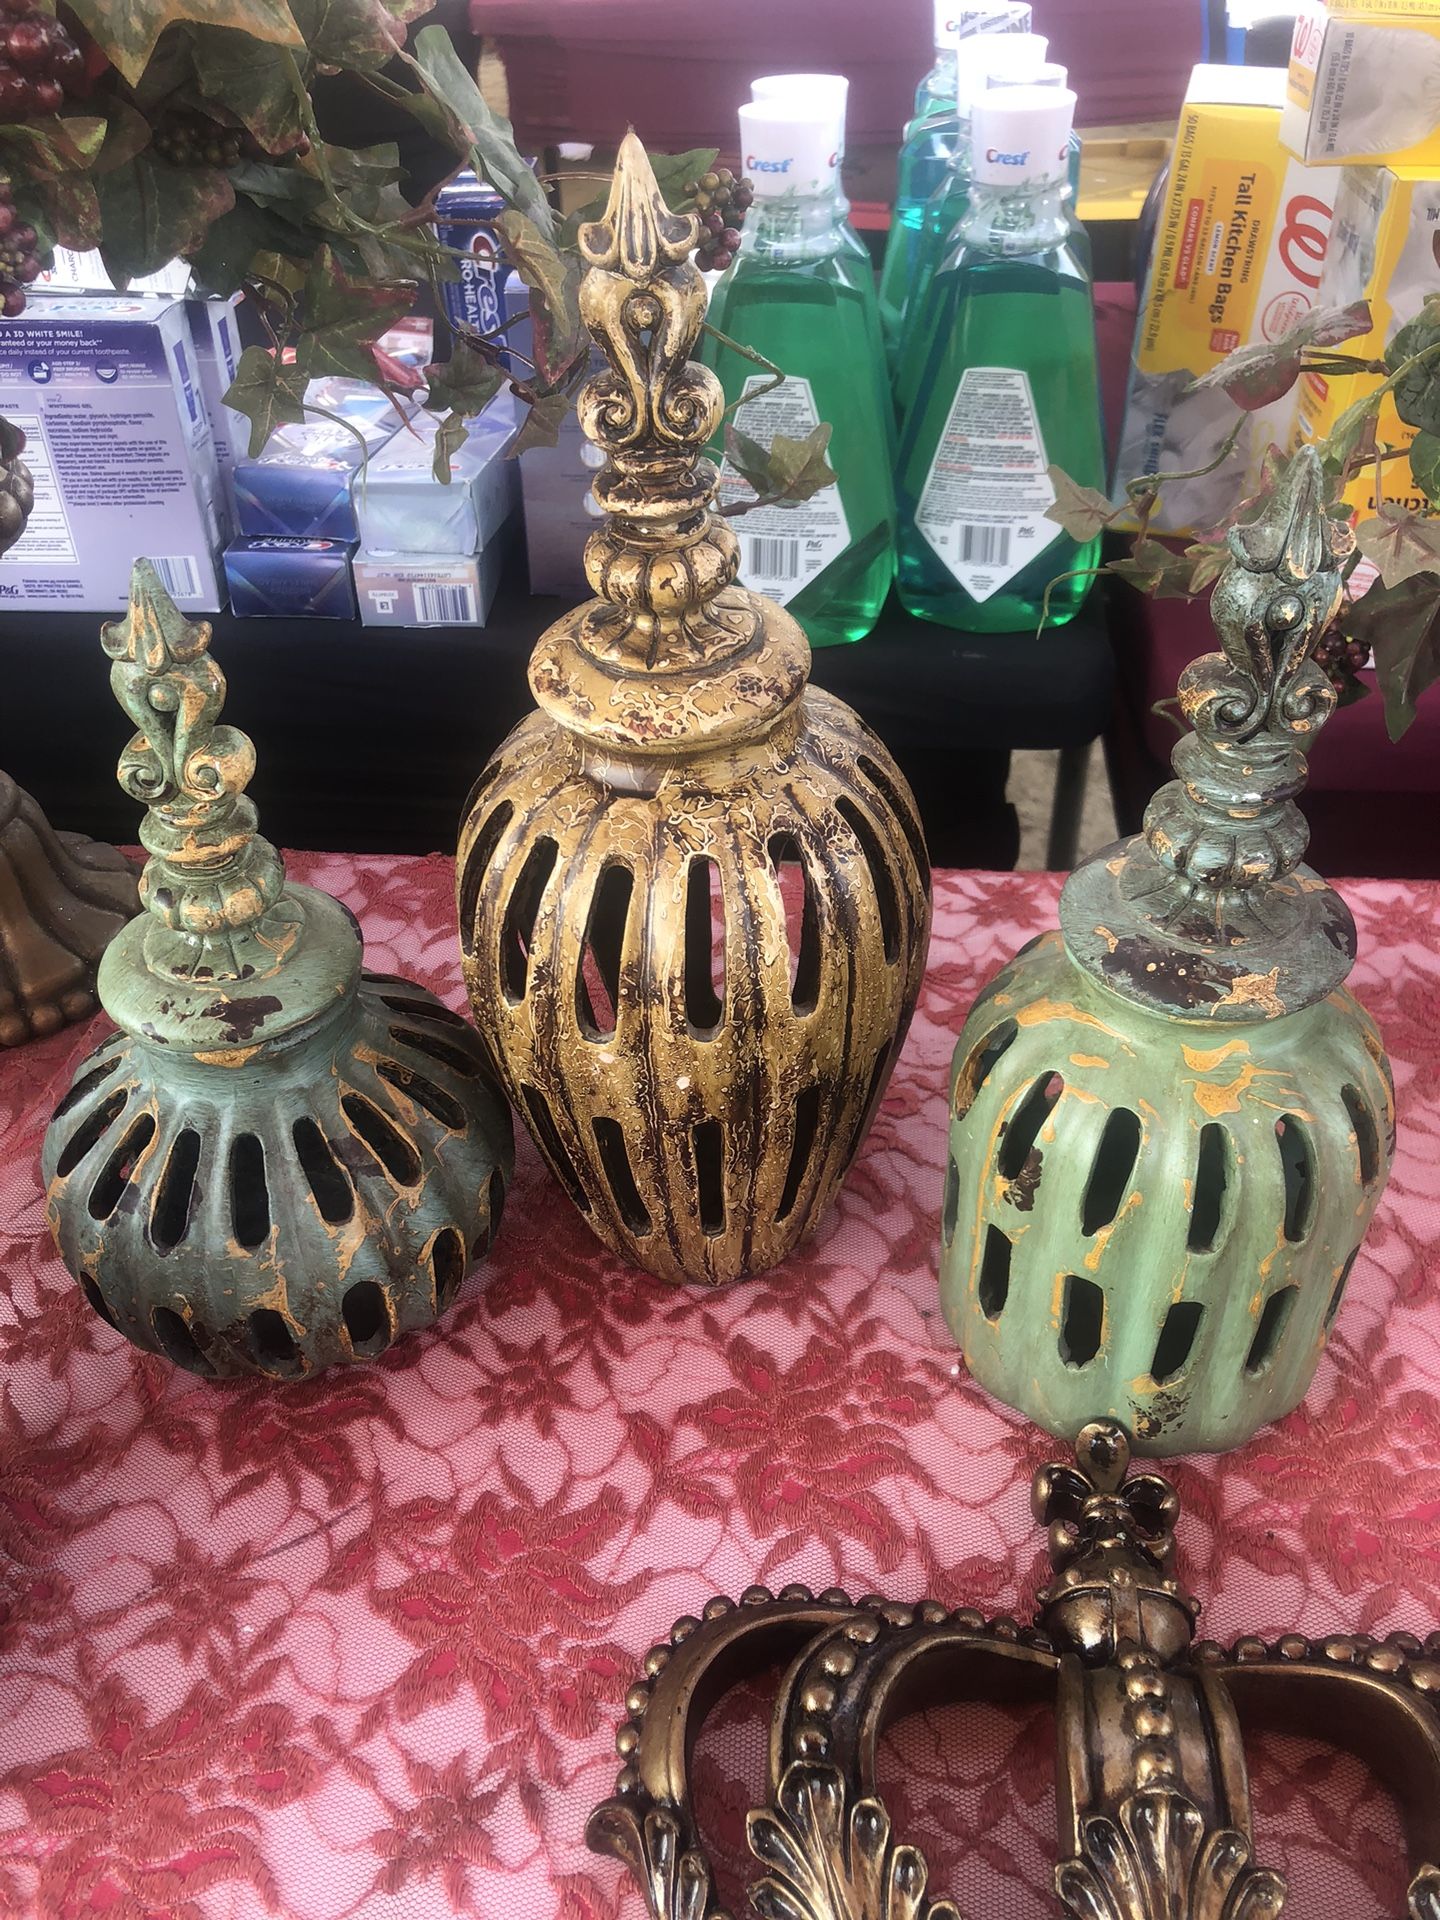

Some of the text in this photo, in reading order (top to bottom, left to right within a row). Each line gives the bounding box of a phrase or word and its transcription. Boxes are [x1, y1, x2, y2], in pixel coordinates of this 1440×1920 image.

[1183, 125, 1197, 144] BAGS
[746, 155, 793, 173] Crest
[986, 149, 1030, 166] Crest
[1177, 158, 1191, 173] GAL
[1175, 173, 1188, 183] 24
[1173, 182, 1186, 192] IN
[1234, 171, 1256, 207] Tall
[1205, 202, 1213, 214] UP
[1185, 205, 1199, 243] COMPARE
[1203, 216, 1210, 225] TO
[1164, 233, 1176, 246] 0.9
[1219, 208, 1249, 280] Kitchen
[1183, 243, 1191, 255] VS
[1207, 224, 1222, 272] LEMON SCENT
[1239, 219, 1260, 284] DRAWSTRING
[1206, 280, 1232, 325] Bags
[8, 348, 23, 356] daily
[36, 340, 52, 348] your
[54, 340, 78, 348] money
